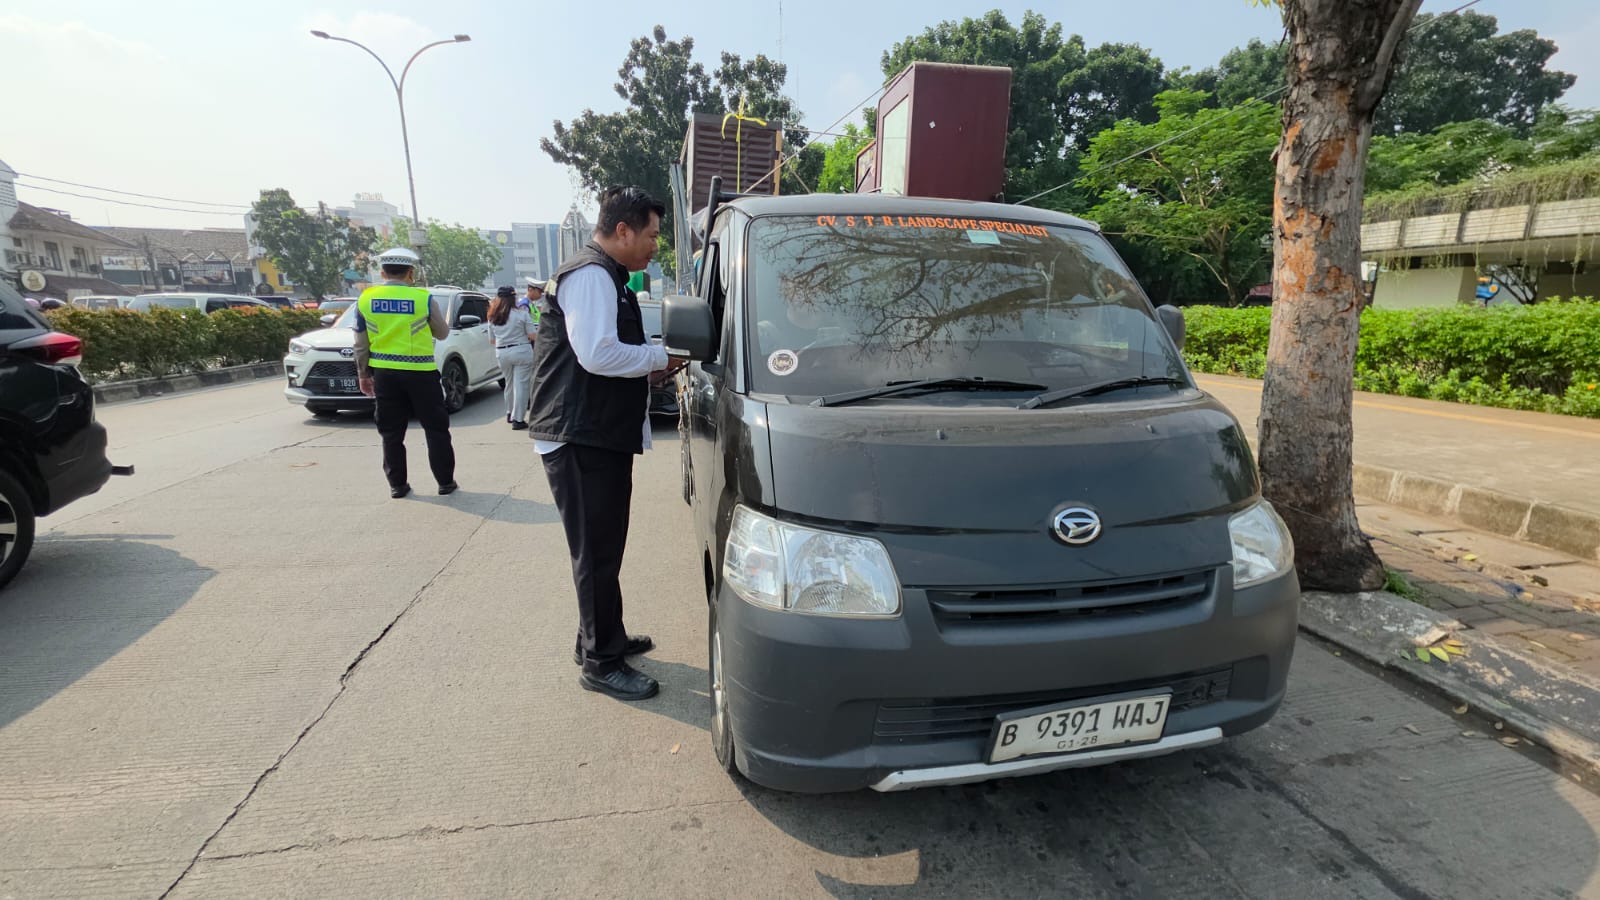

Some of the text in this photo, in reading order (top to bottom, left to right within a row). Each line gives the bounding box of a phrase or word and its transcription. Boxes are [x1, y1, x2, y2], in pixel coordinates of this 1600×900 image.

[846, 215, 855, 227] S
[863, 215, 874, 227] T
[881, 215, 894, 227] R
[898, 216, 979, 230] LANDSCAPE
[979, 220, 1048, 237] SPECIALIST
[373, 300, 413, 312] POLISI
[1001, 701, 1164, 747] B 9391 WAJ
